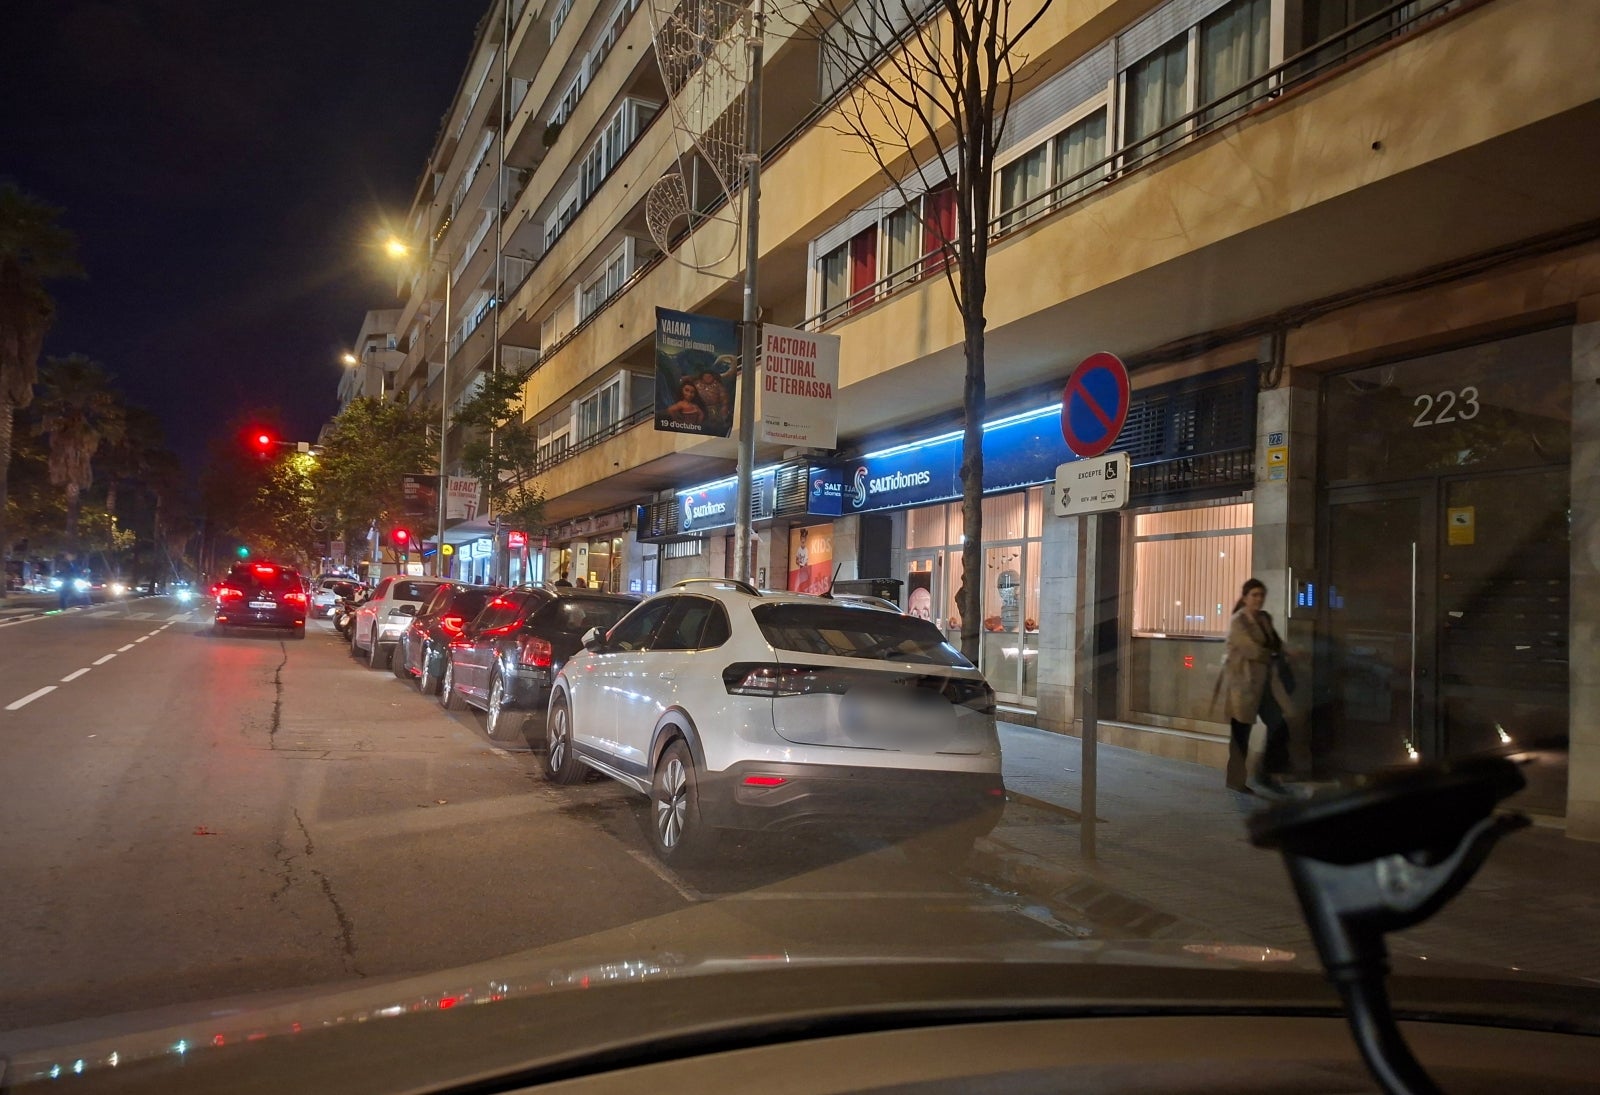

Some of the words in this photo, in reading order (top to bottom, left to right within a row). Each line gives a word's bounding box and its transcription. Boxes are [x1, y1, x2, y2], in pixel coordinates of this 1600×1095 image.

[661, 319, 691, 337] VAIANA
[767, 335, 817, 359] FACTORIA
[766, 355, 816, 378] CULTURAL
[765, 375, 779, 392] DE
[779, 376, 832, 399] TERRASSA
[1413, 386, 1480, 428] 223
[670, 421, 702, 430] d'octubre
[1270, 434, 1282, 444] 223
[869, 470, 931, 494] SALTidiomes
[1078, 470, 1102, 480] EXCEPTE
[824, 482, 842, 491] SALT
[811, 537, 832, 553] KIDS
